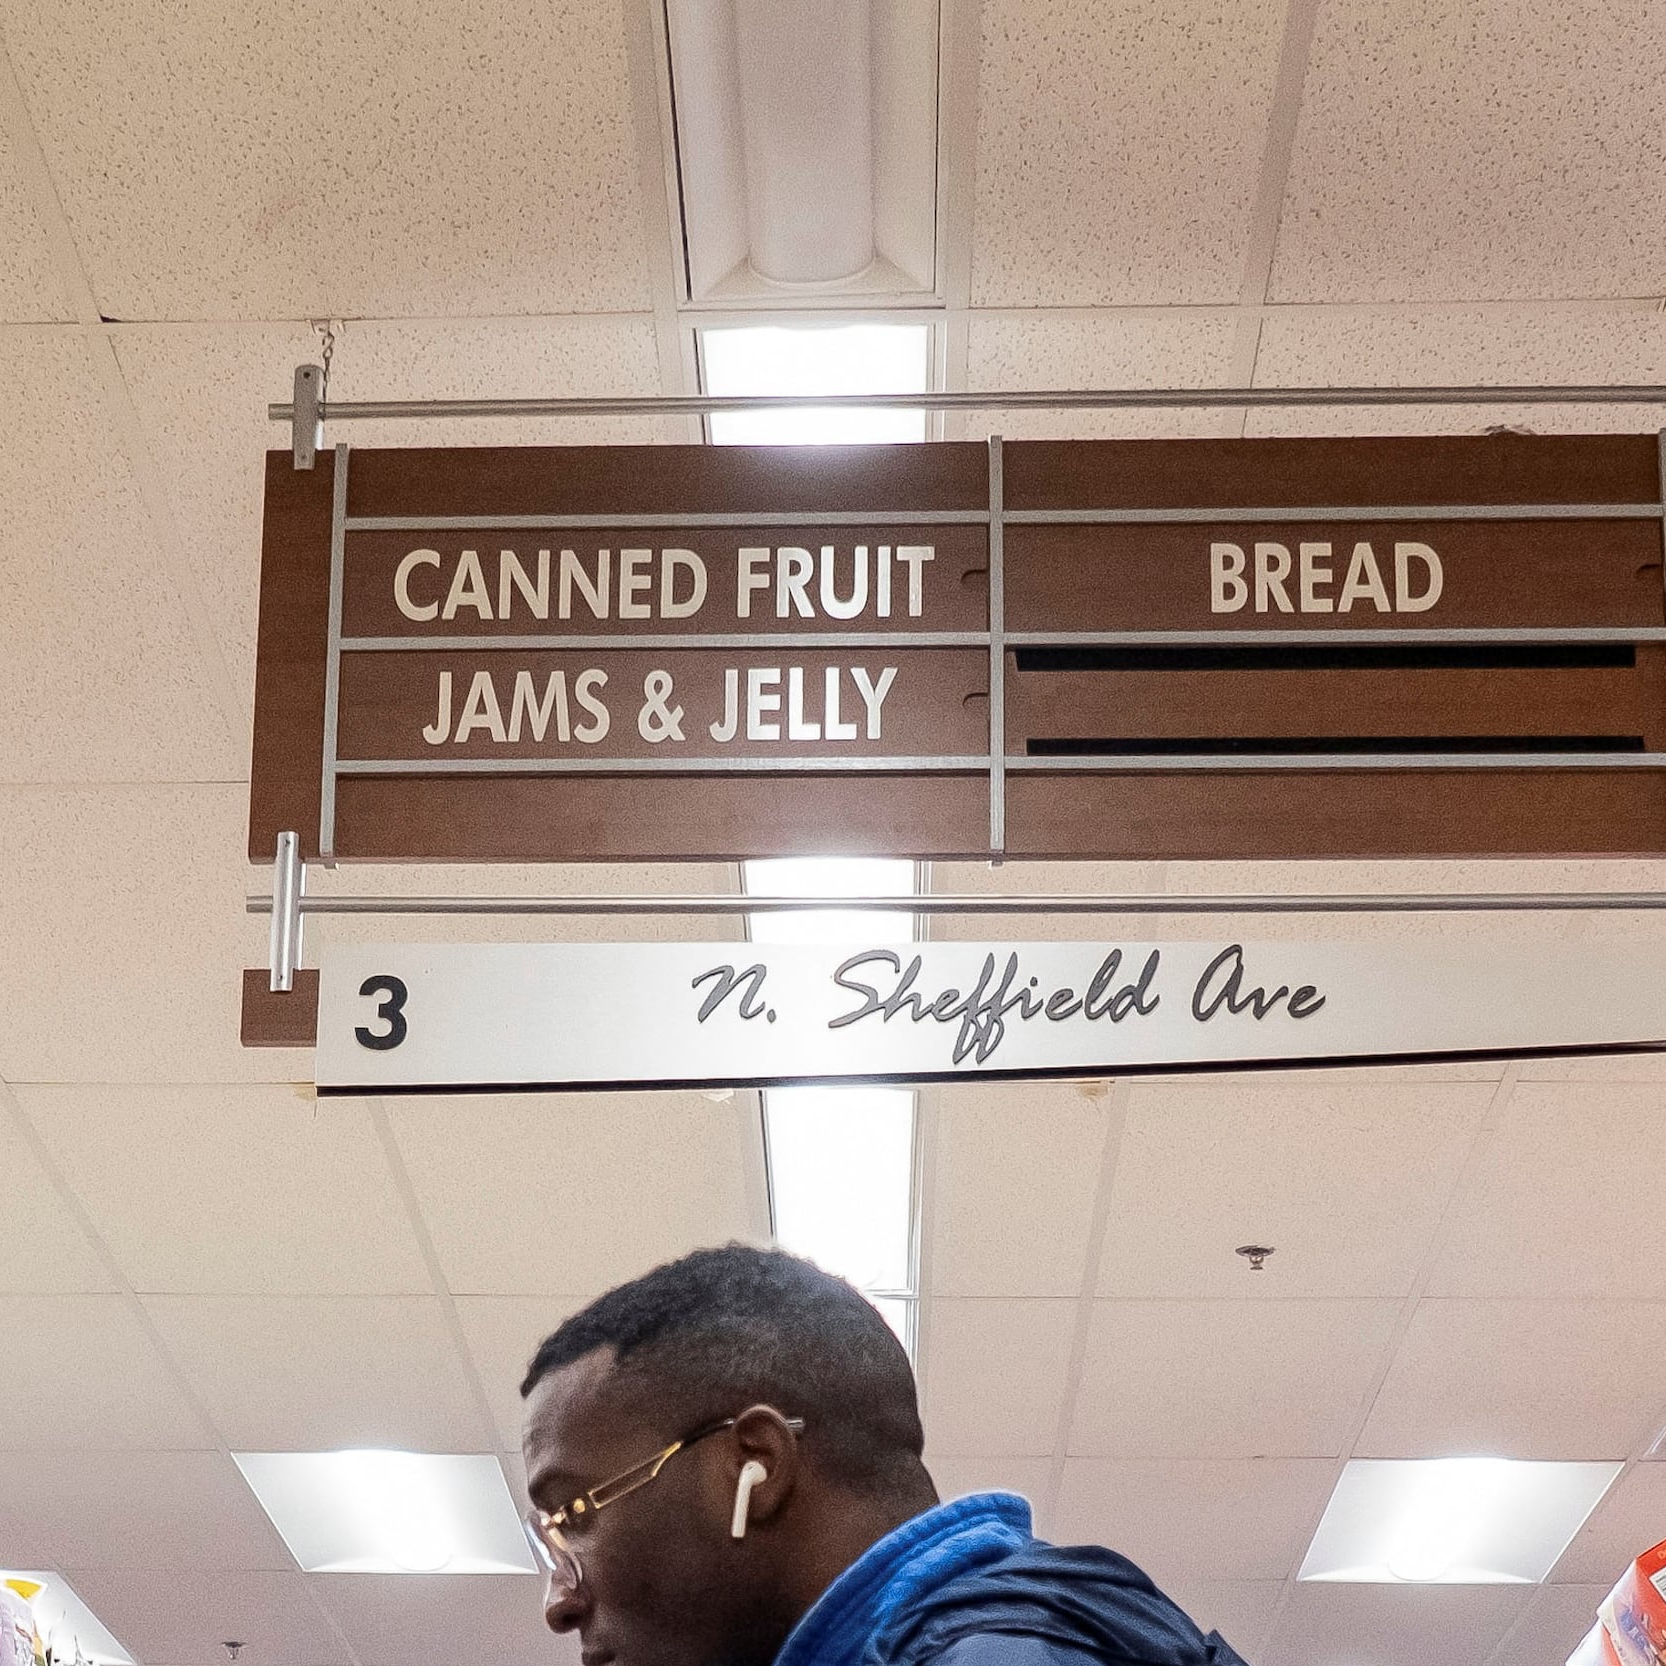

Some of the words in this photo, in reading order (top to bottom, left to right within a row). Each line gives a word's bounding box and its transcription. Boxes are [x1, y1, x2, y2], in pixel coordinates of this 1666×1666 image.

[393, 548, 708, 621] CANNED
[737, 545, 935, 619] FRUIT
[1210, 542, 1444, 614] BREAD
[422, 668, 610, 745] JAMS
[637, 669, 686, 743] &
[709, 666, 897, 742] JELLY
[354, 974, 408, 1052] 3
[690, 963, 777, 1025] N.
[827, 947, 1160, 1066] Sheffield
[1191, 943, 1327, 1023] Ave
